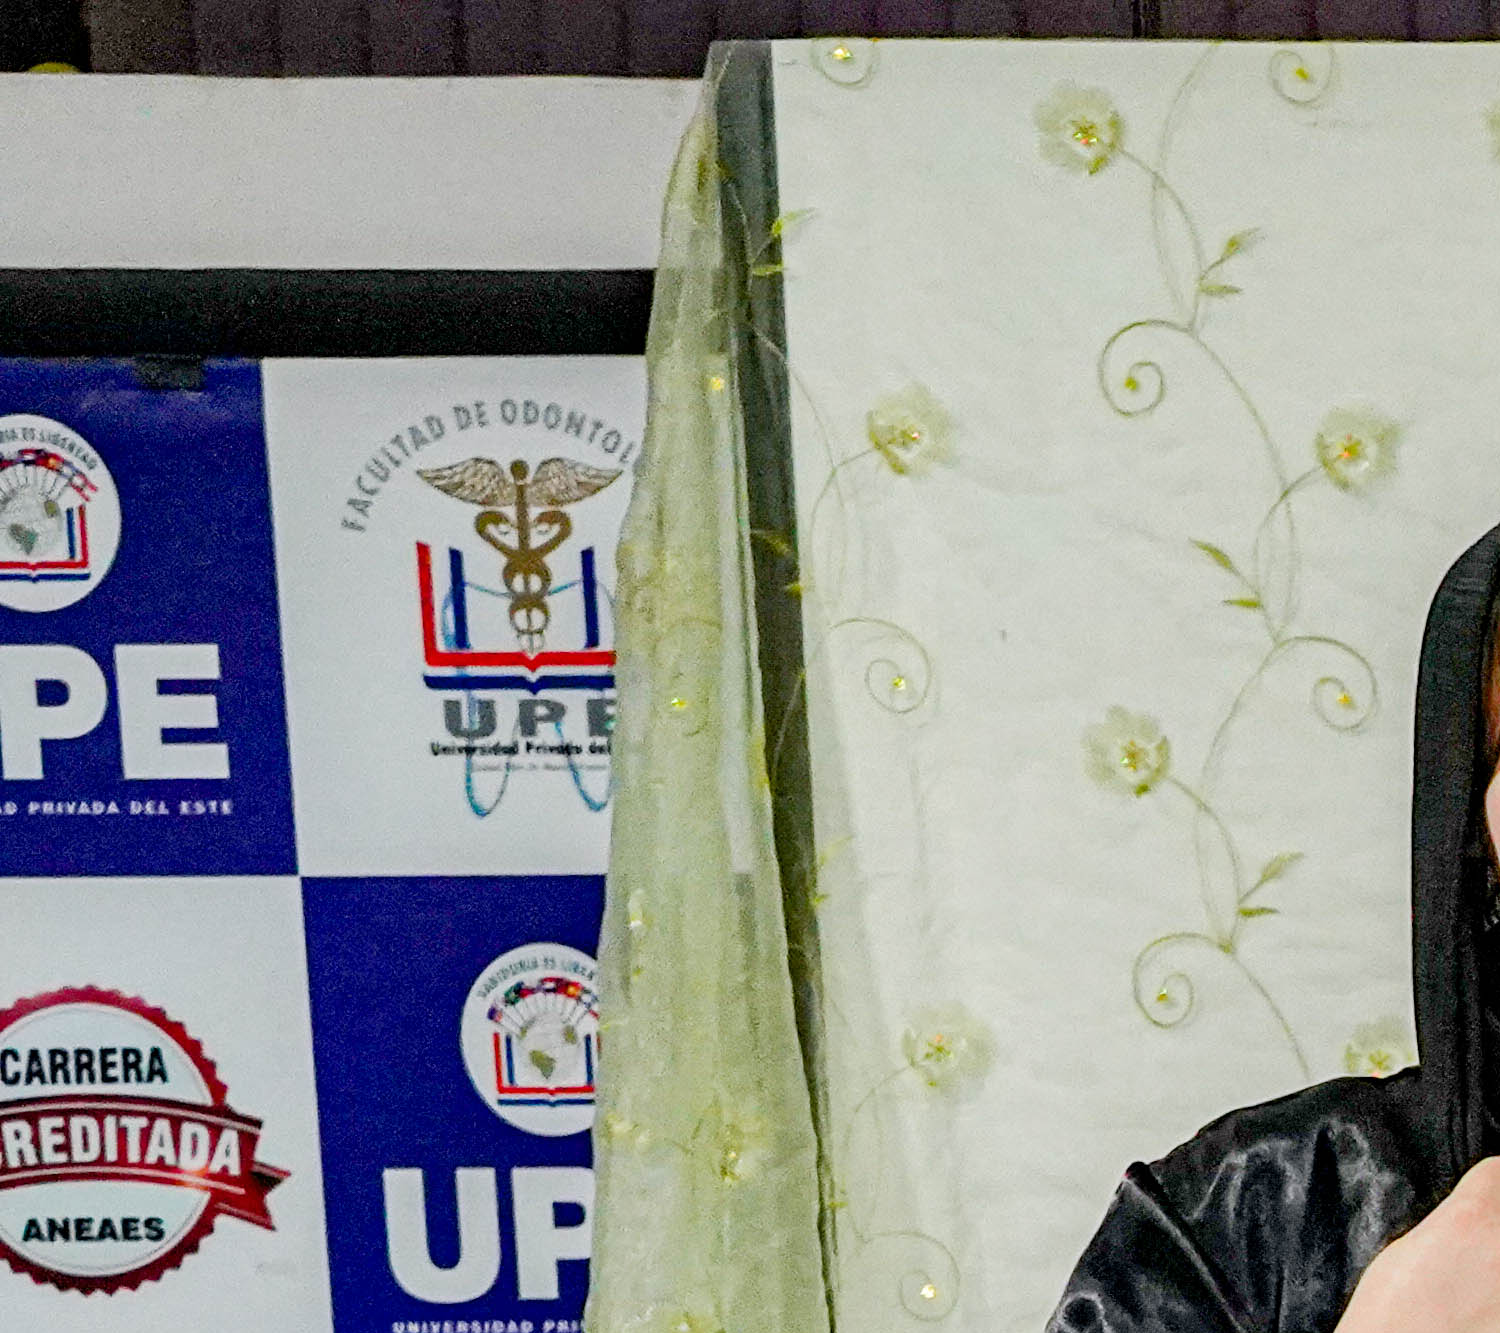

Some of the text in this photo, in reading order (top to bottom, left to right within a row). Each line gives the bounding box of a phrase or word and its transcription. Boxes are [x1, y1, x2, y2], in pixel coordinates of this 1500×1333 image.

[342, 414, 446, 533] FACULTAD
[453, 400, 489, 431] DE
[28, 800, 120, 815] PRIVADA
[130, 800, 169, 815] DEL
[179, 800, 233, 815] ESTE
[0, 1047, 168, 1085] CARRERA
[0, 1115, 241, 1176] REDITADA
[22, 1217, 165, 1242] ANEAES
[382, 1166, 596, 1304] UP
